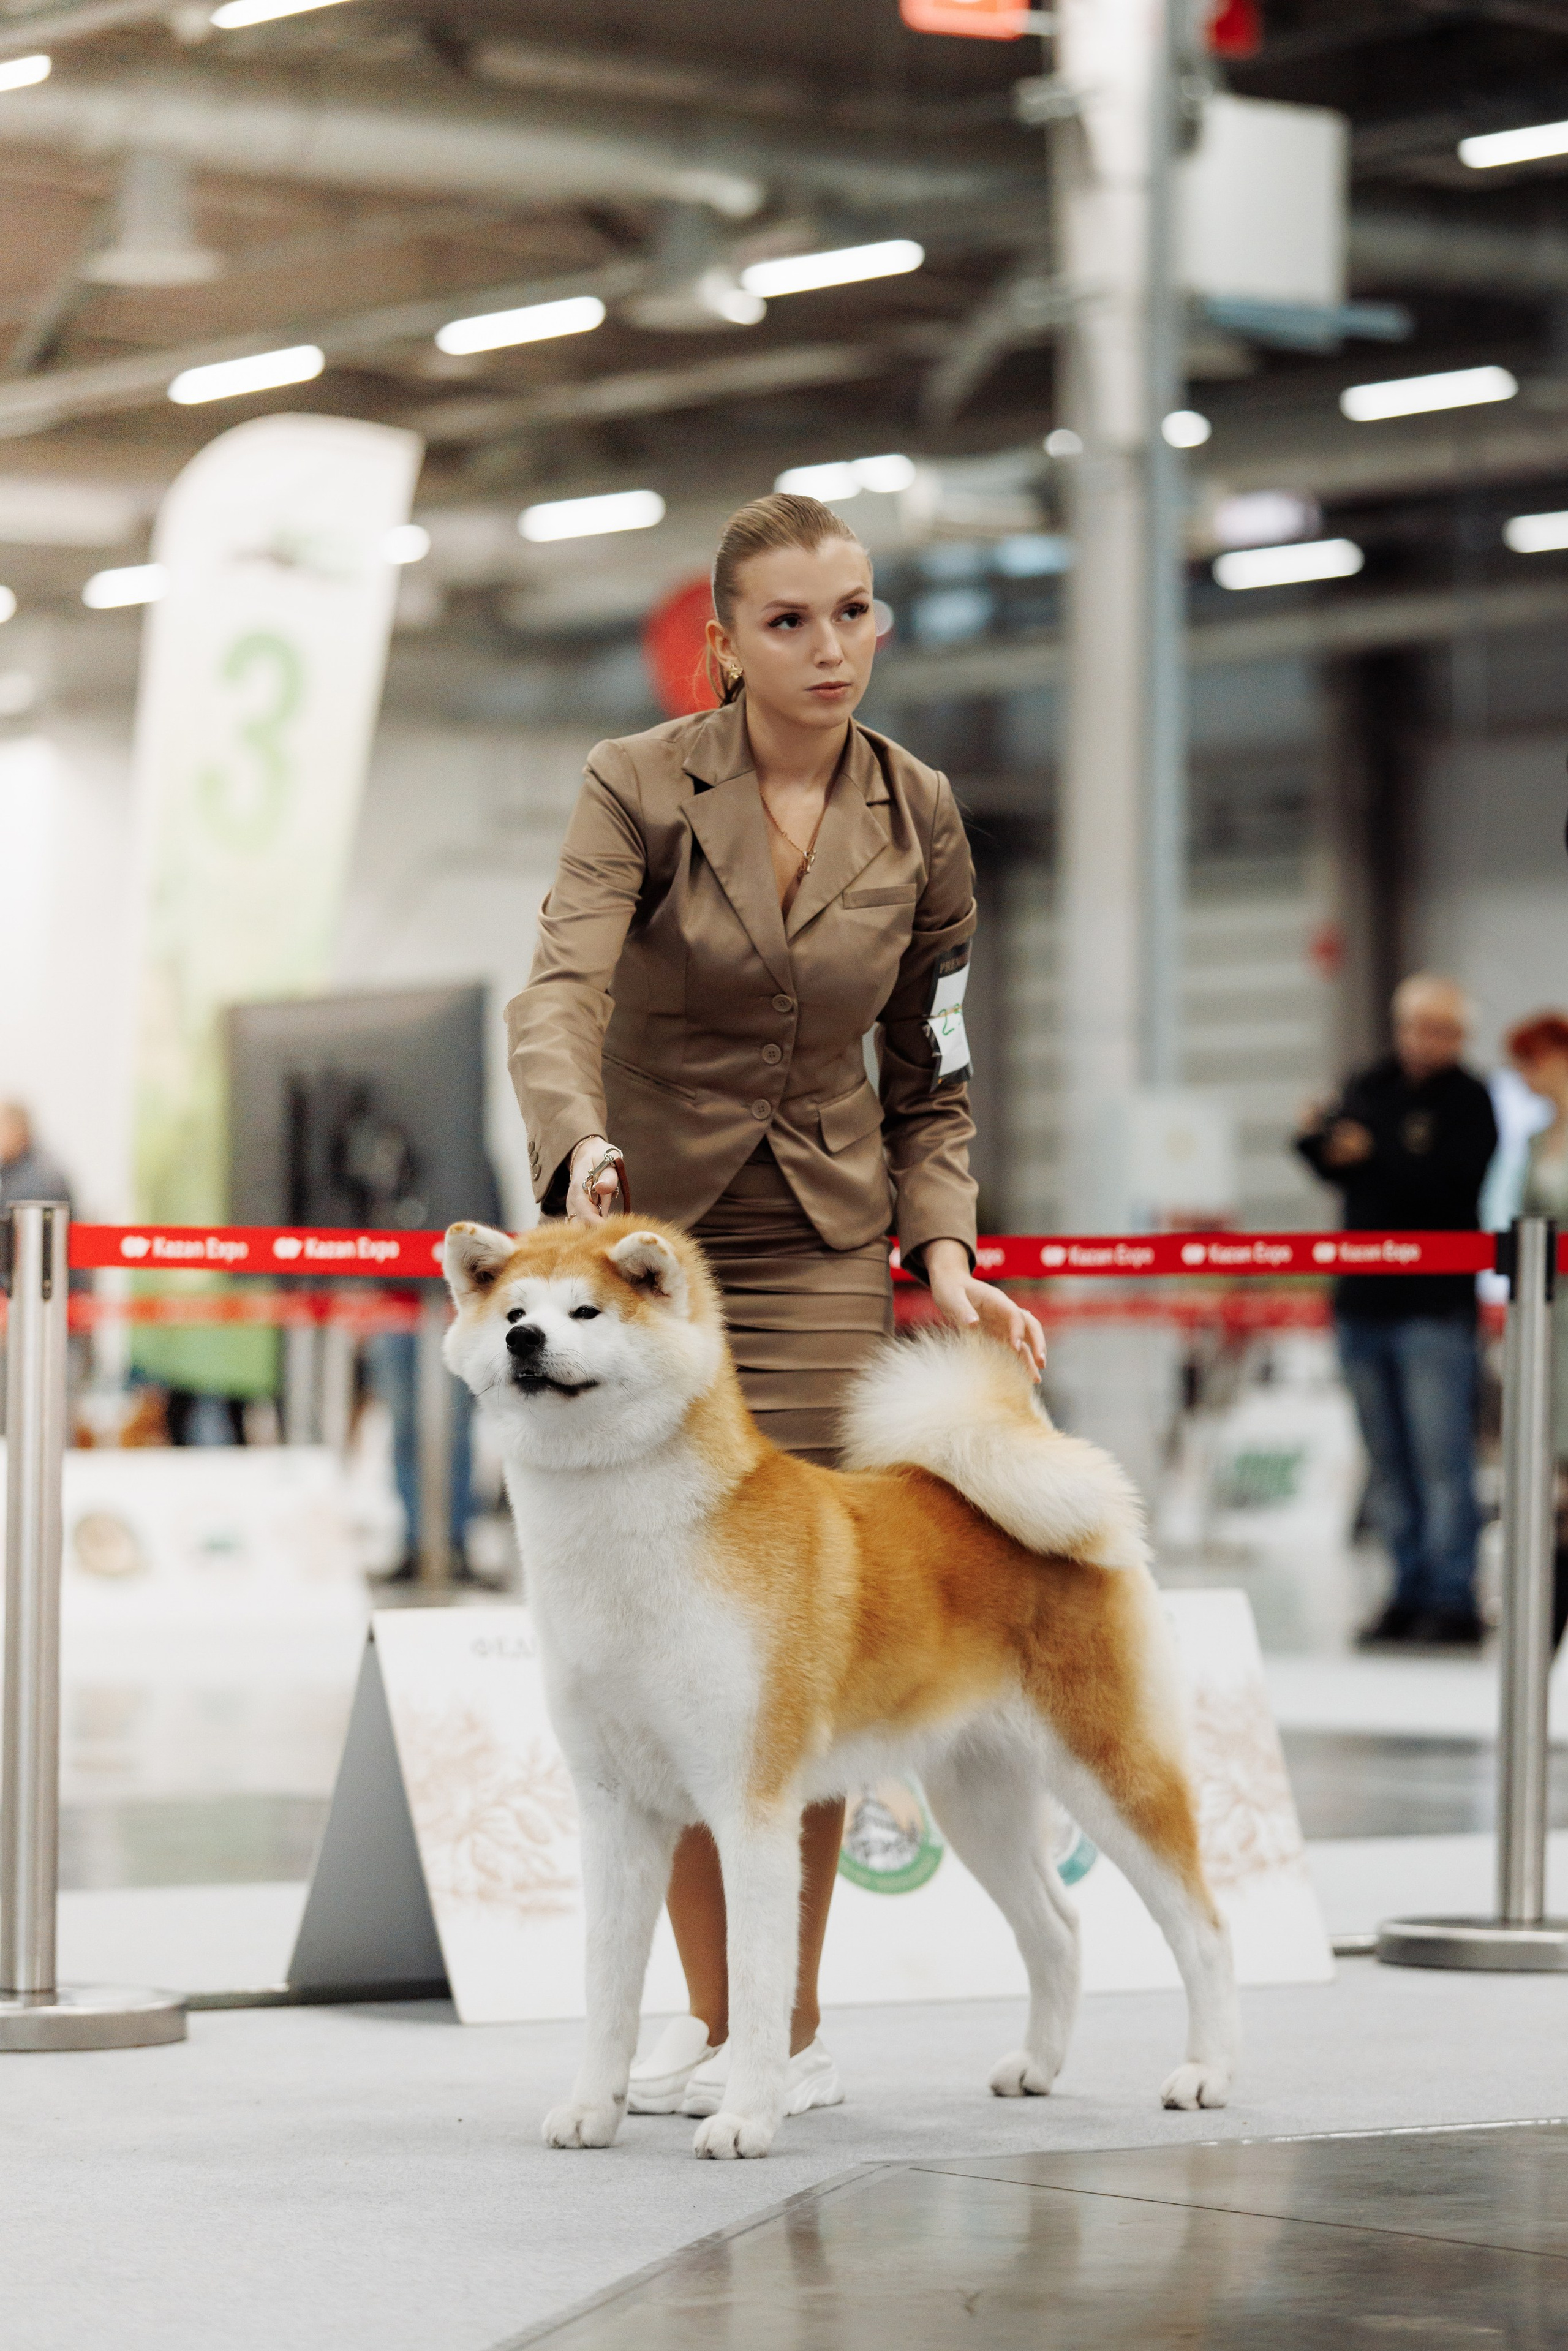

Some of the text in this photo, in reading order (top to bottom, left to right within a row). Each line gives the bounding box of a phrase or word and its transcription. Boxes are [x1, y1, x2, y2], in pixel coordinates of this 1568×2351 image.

[195, 631, 307, 850] 3
[153, 1237, 249, 1264] Kazan Expo
[305, 1237, 399, 1263] Kazan Expo
[1068, 1243, 1154, 1269] Kazan Expo
[1208, 1241, 1293, 1267] Kazan Expo
[1338, 1239, 1421, 1266] Kazan Expo
